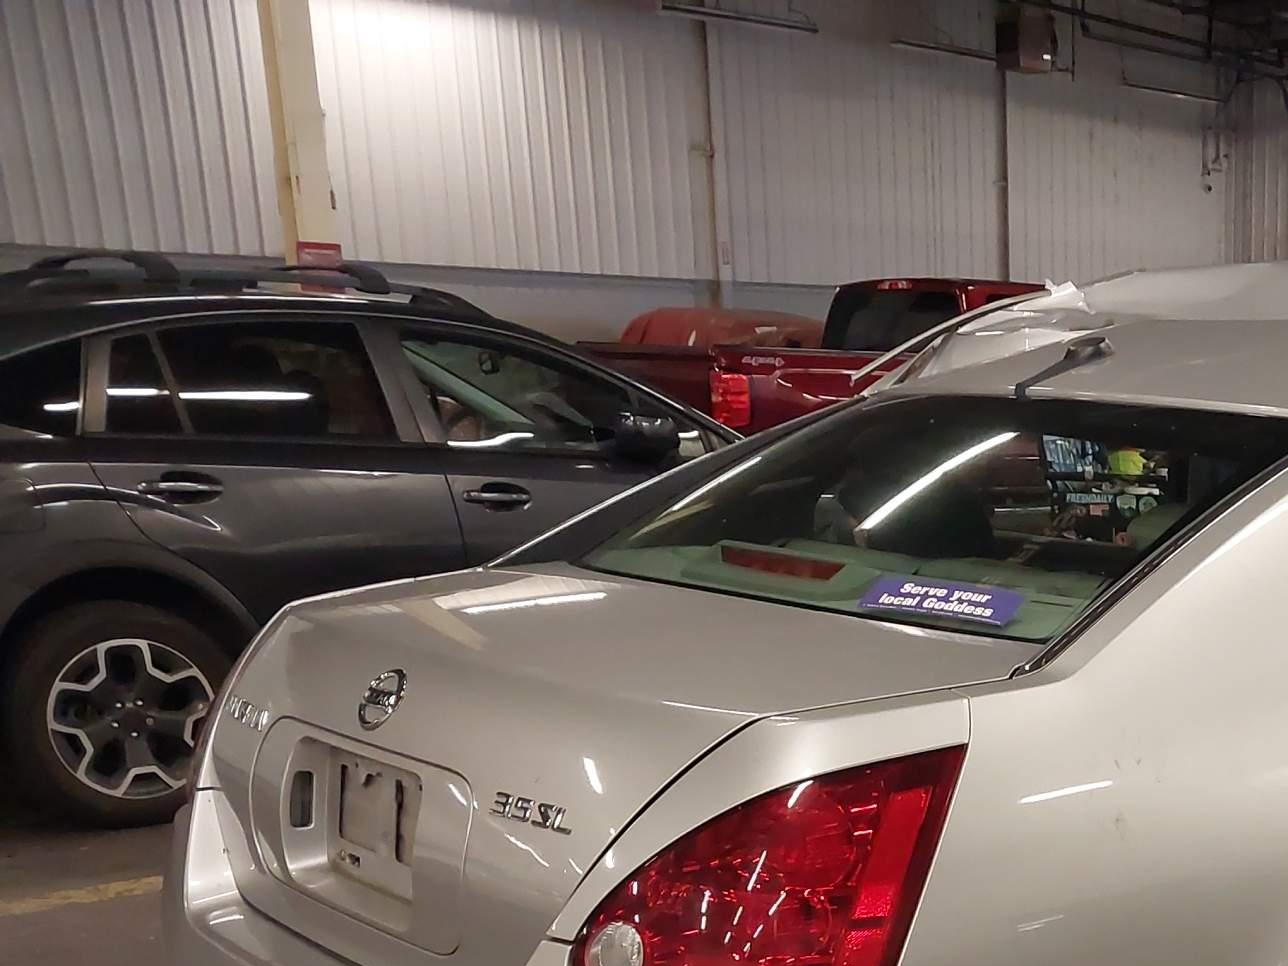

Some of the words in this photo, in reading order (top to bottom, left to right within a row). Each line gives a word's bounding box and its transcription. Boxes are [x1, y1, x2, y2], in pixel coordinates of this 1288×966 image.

[900, 583, 948, 597] Serve
[949, 590, 992, 603] your
[879, 593, 919, 607] local
[923, 598, 994, 617] Goddess
